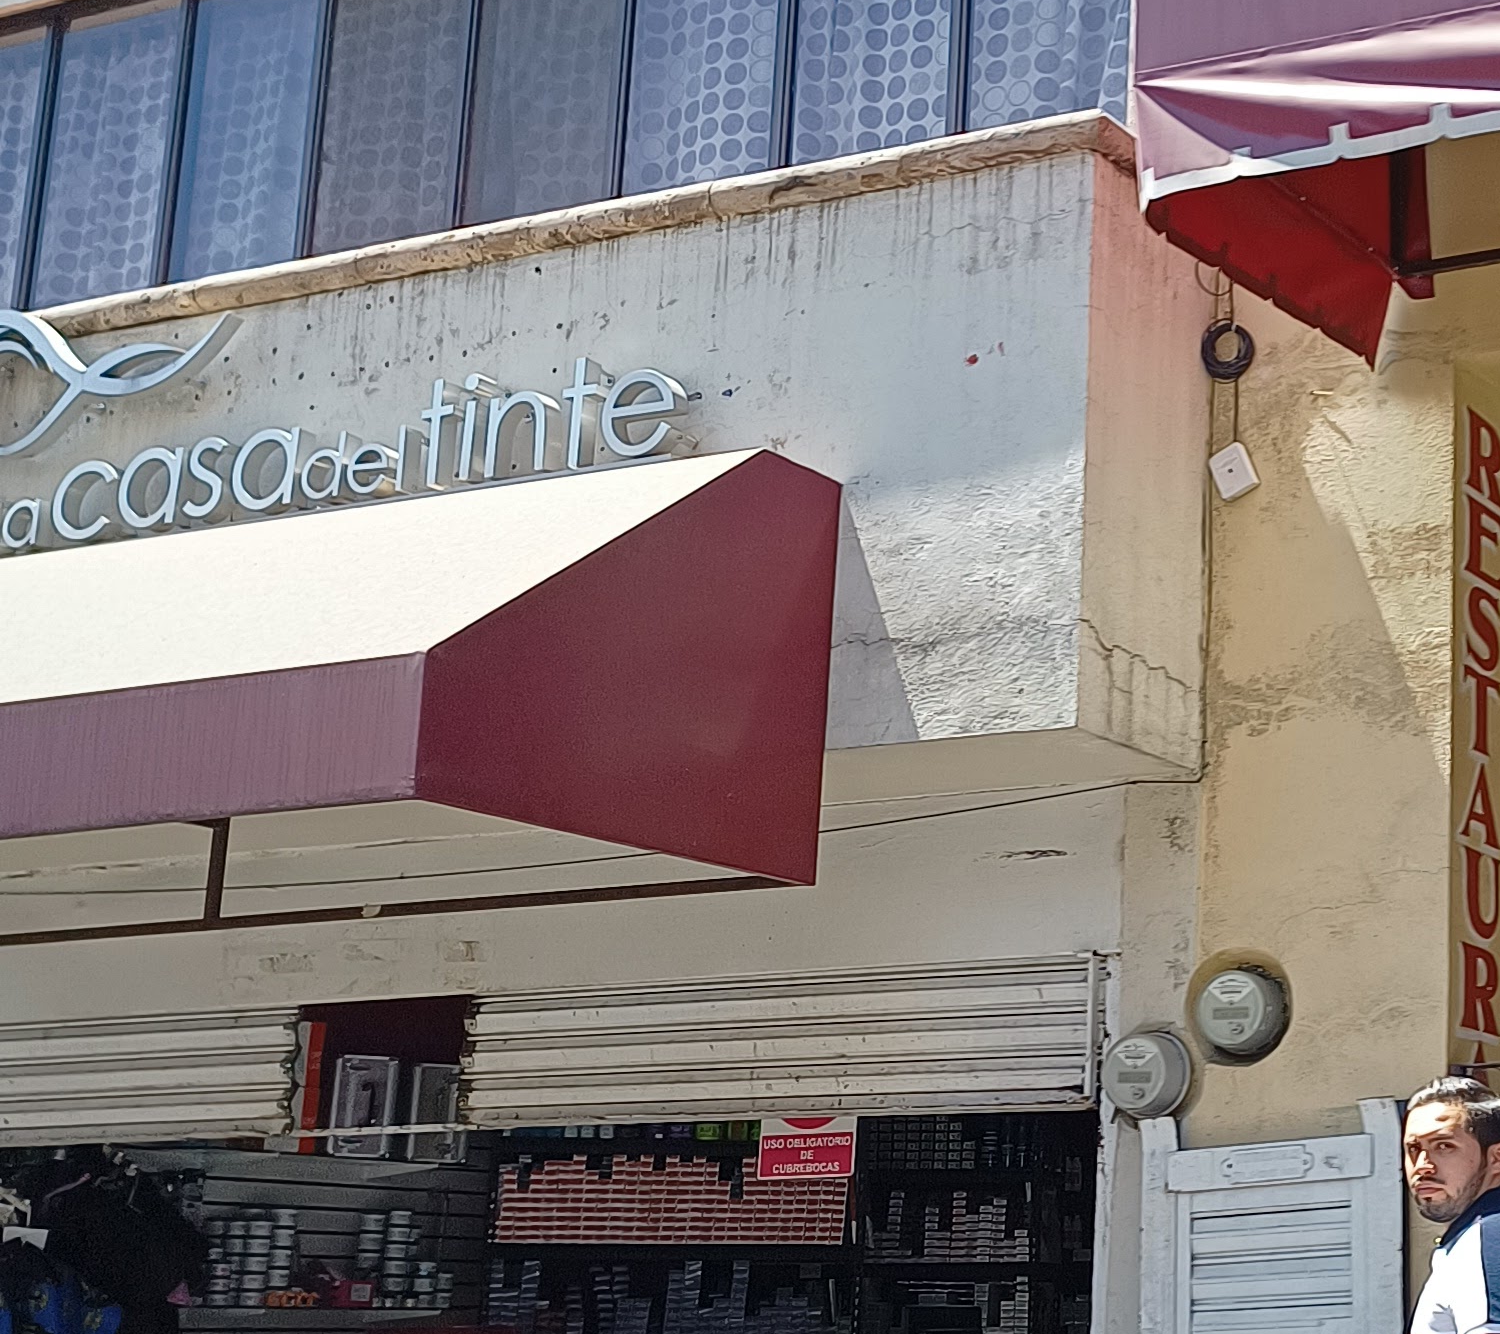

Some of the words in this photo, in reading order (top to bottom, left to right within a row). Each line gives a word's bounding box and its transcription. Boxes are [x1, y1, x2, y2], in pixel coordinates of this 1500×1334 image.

[2, 496, 41, 548] a
[52, 426, 300, 541] casa
[301, 425, 412, 499] del
[421, 357, 684, 487] tinte
[763, 1138, 785, 1149] USO
[786, 1136, 851, 1149] OBLIGATORIO
[799, 1150, 815, 1160] DE
[772, 1162, 840, 1174] CUBREBOCAS
